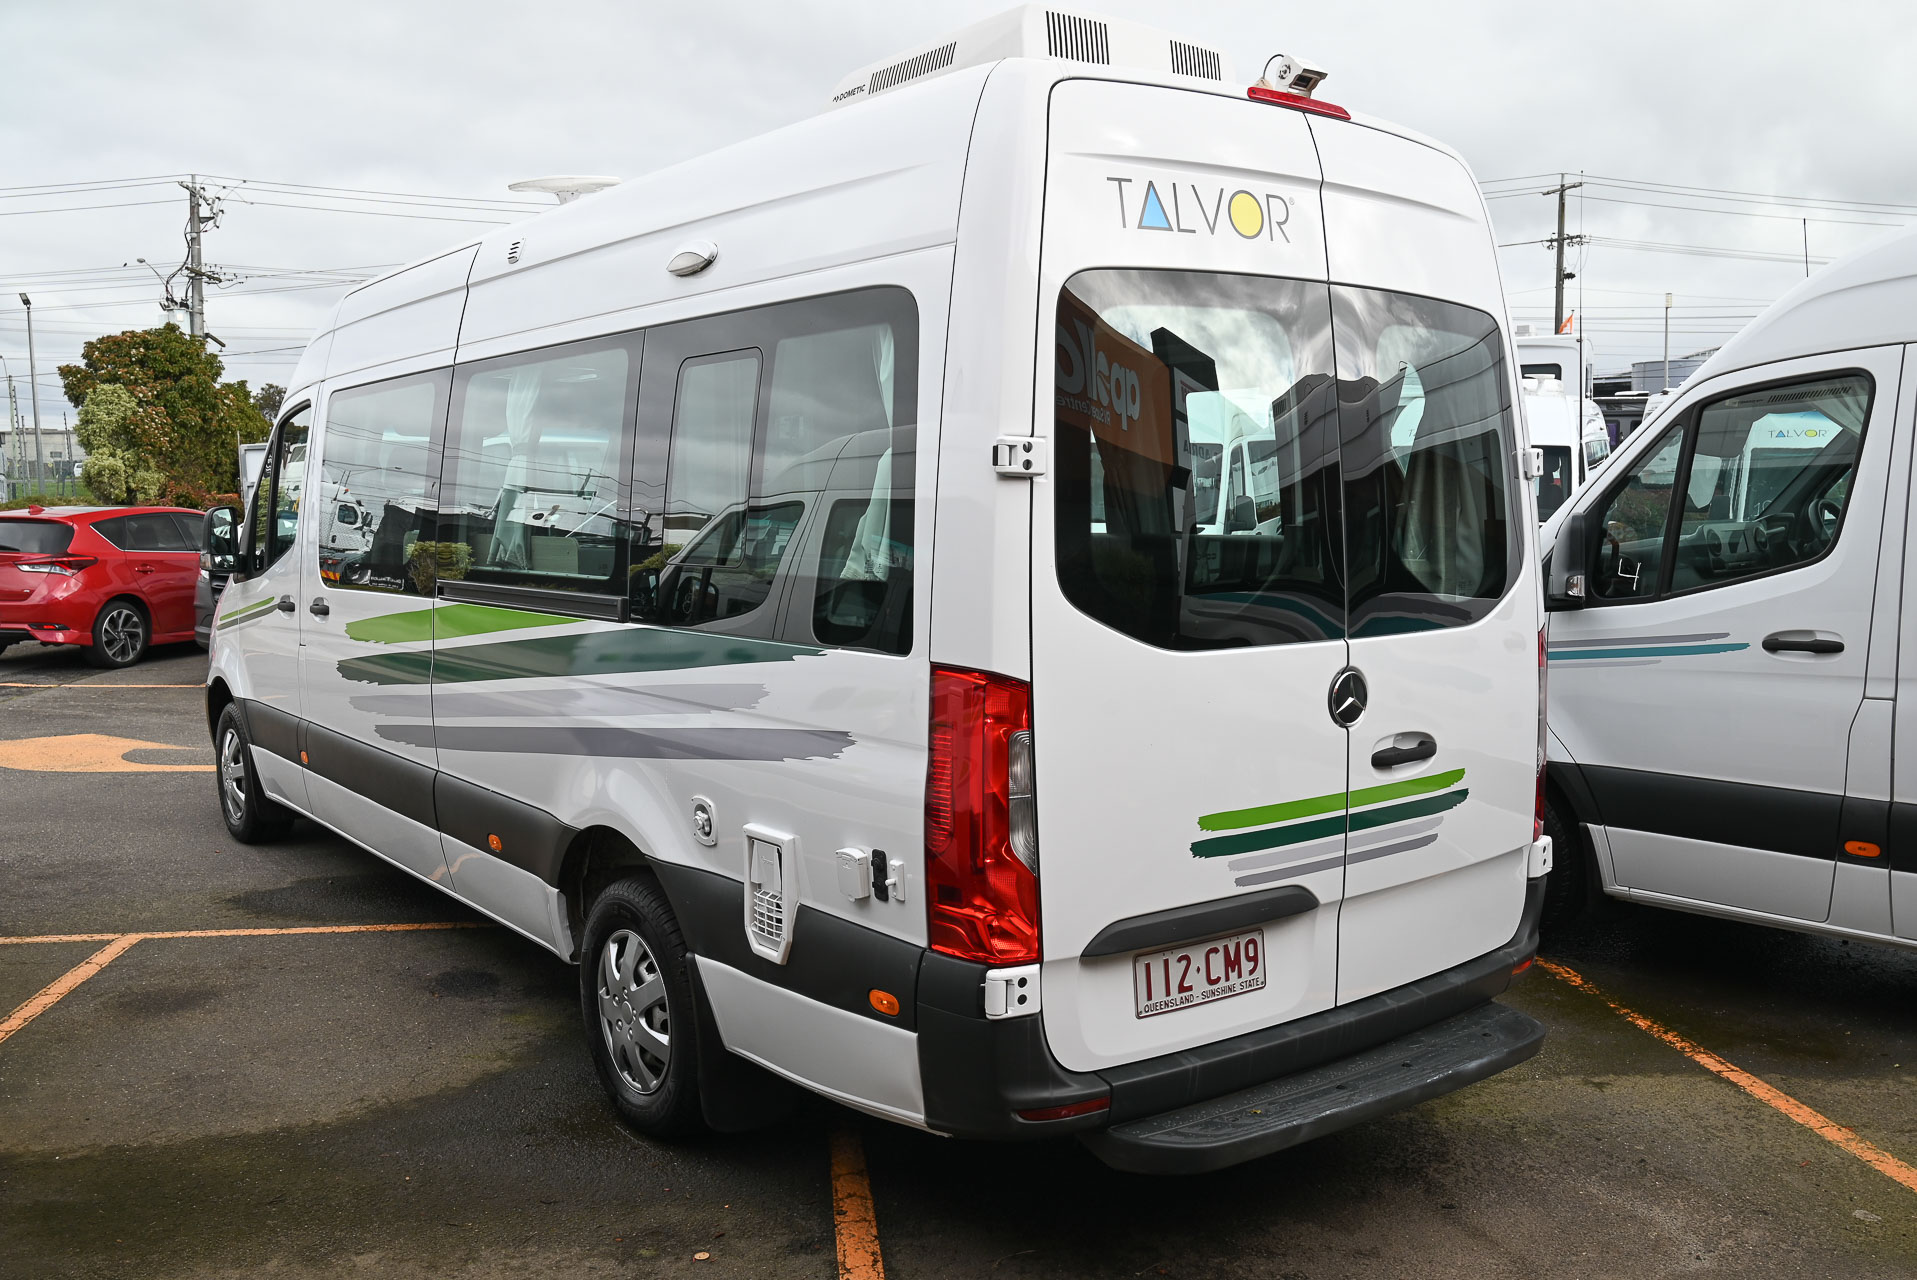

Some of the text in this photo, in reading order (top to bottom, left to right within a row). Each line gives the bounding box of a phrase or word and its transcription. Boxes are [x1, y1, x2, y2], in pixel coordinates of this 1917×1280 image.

[839, 84, 866, 101] DOMETIC
[1106, 177, 1290, 243] TALVOR
[1768, 429, 1827, 438] TALVOR
[1143, 994, 1194, 1014] QUEENSLAND
[1201, 983, 1236, 1000] SUNSHINE
[1239, 977, 1260, 990] STATE
